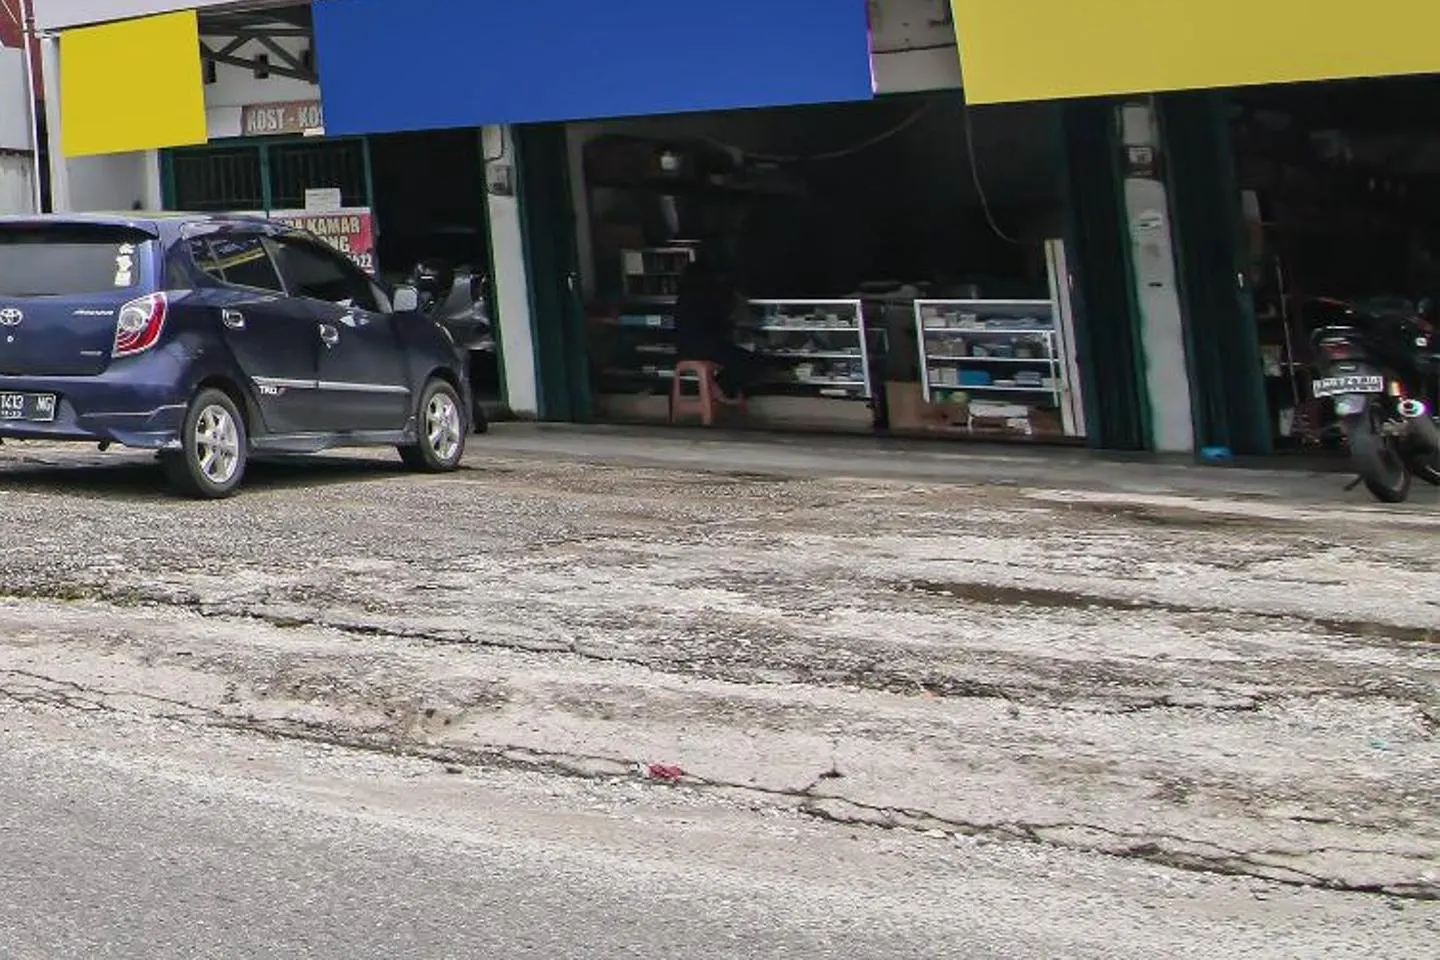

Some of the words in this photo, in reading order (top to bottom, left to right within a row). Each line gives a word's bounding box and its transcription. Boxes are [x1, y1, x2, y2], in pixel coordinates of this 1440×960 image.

[247, 108, 285, 132] KOST
[298, 106, 323, 128] KO
[306, 214, 360, 235] KAMAR
